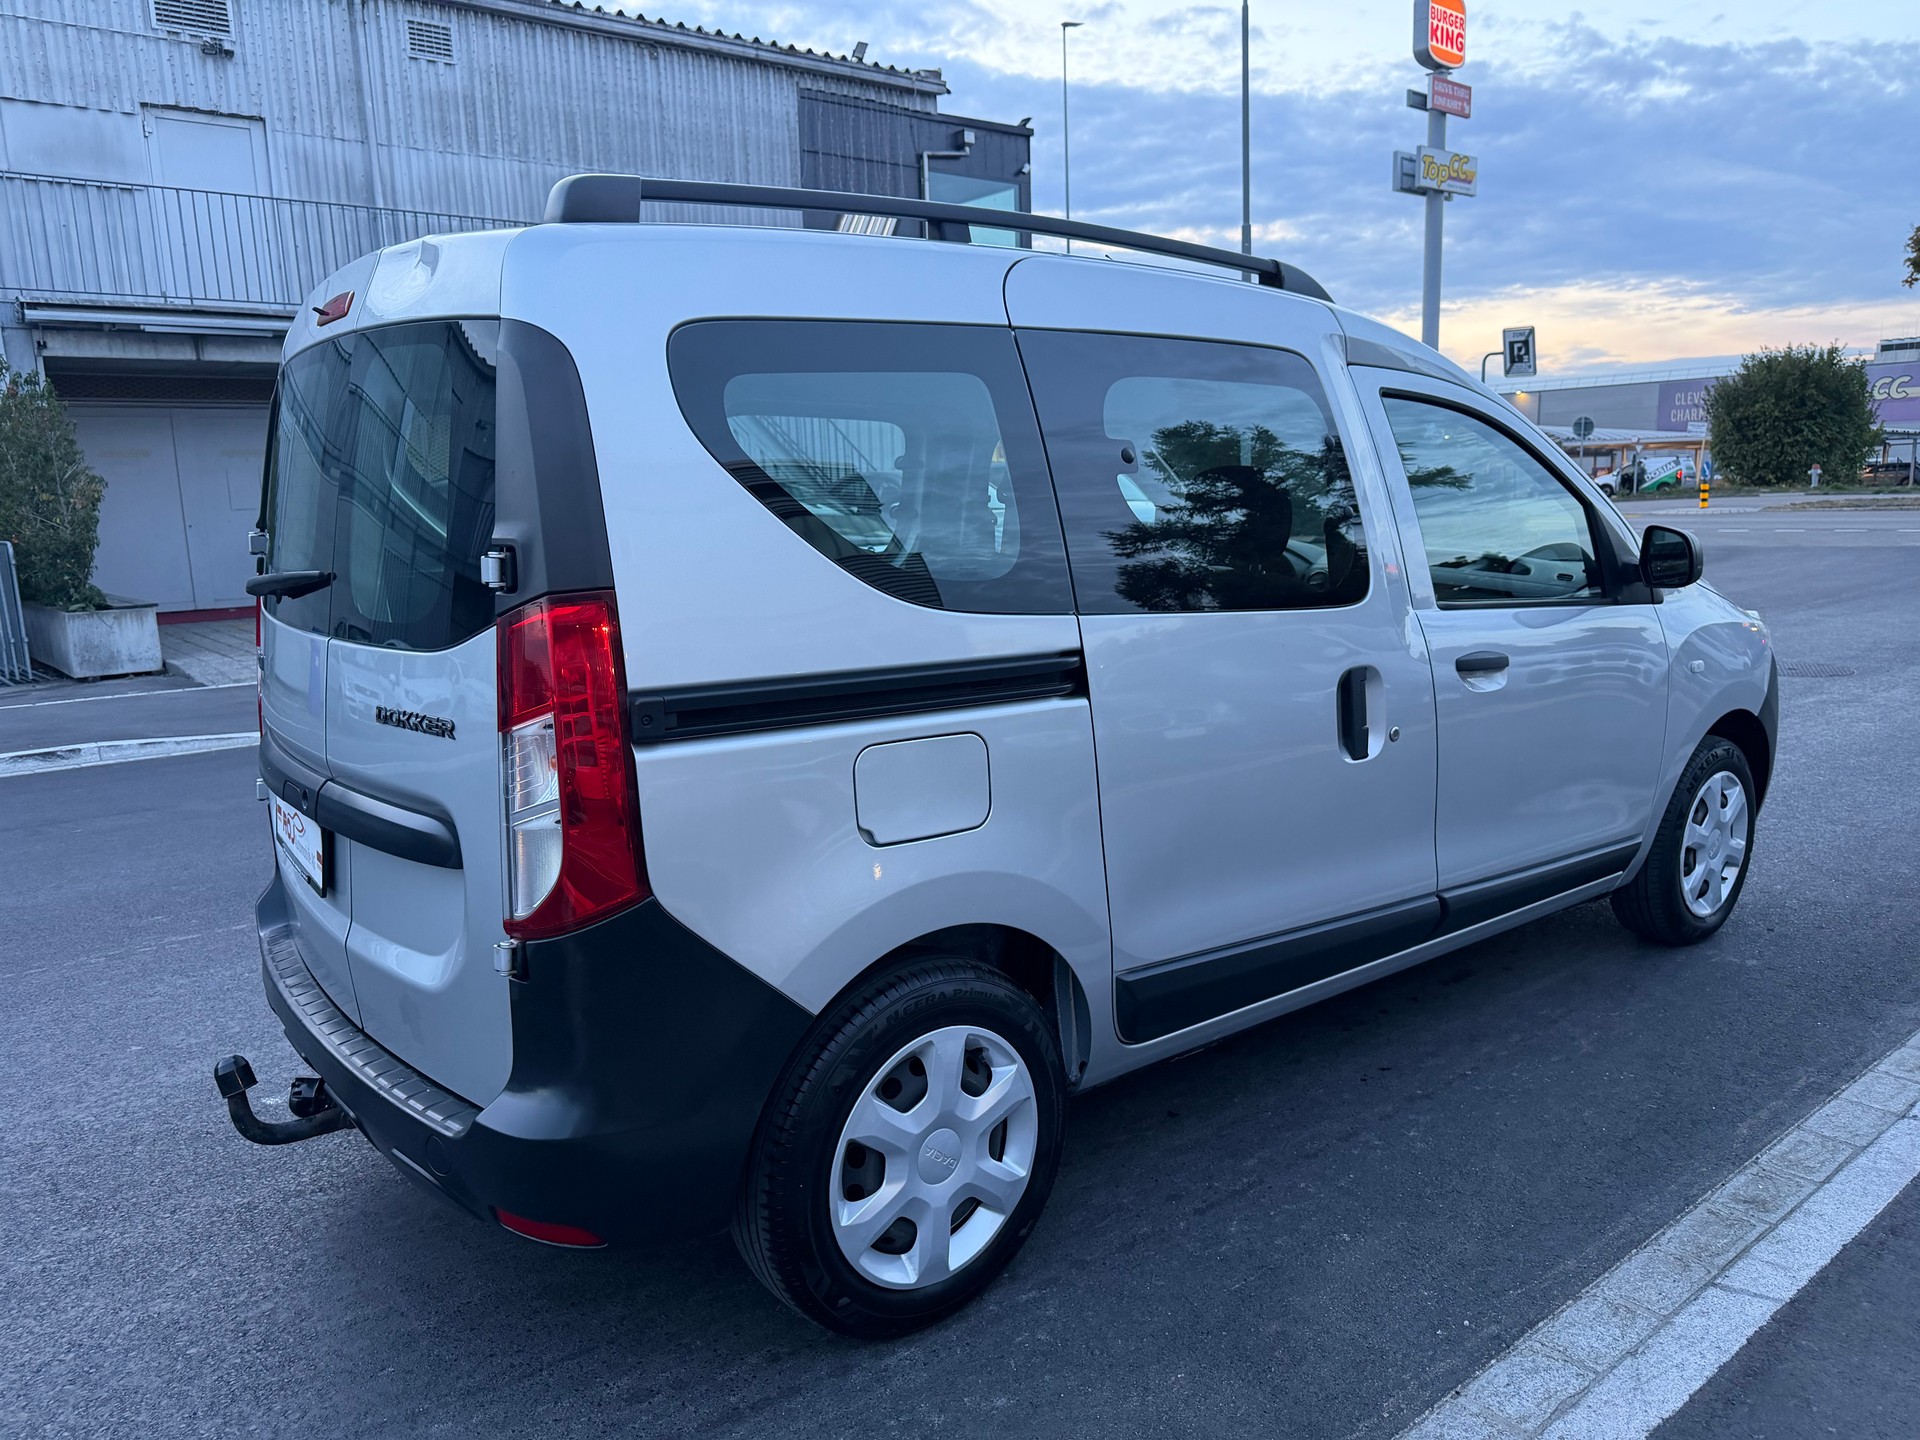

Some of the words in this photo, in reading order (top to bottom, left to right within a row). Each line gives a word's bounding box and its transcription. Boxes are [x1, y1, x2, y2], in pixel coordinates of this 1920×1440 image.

[1430, 5, 1465, 32] BURGER
[1430, 20, 1464, 53] KING
[1422, 153, 1470, 188] TopCC
[375, 705, 457, 741] DOKKER
[1686, 750, 1719, 795] NEXEN
